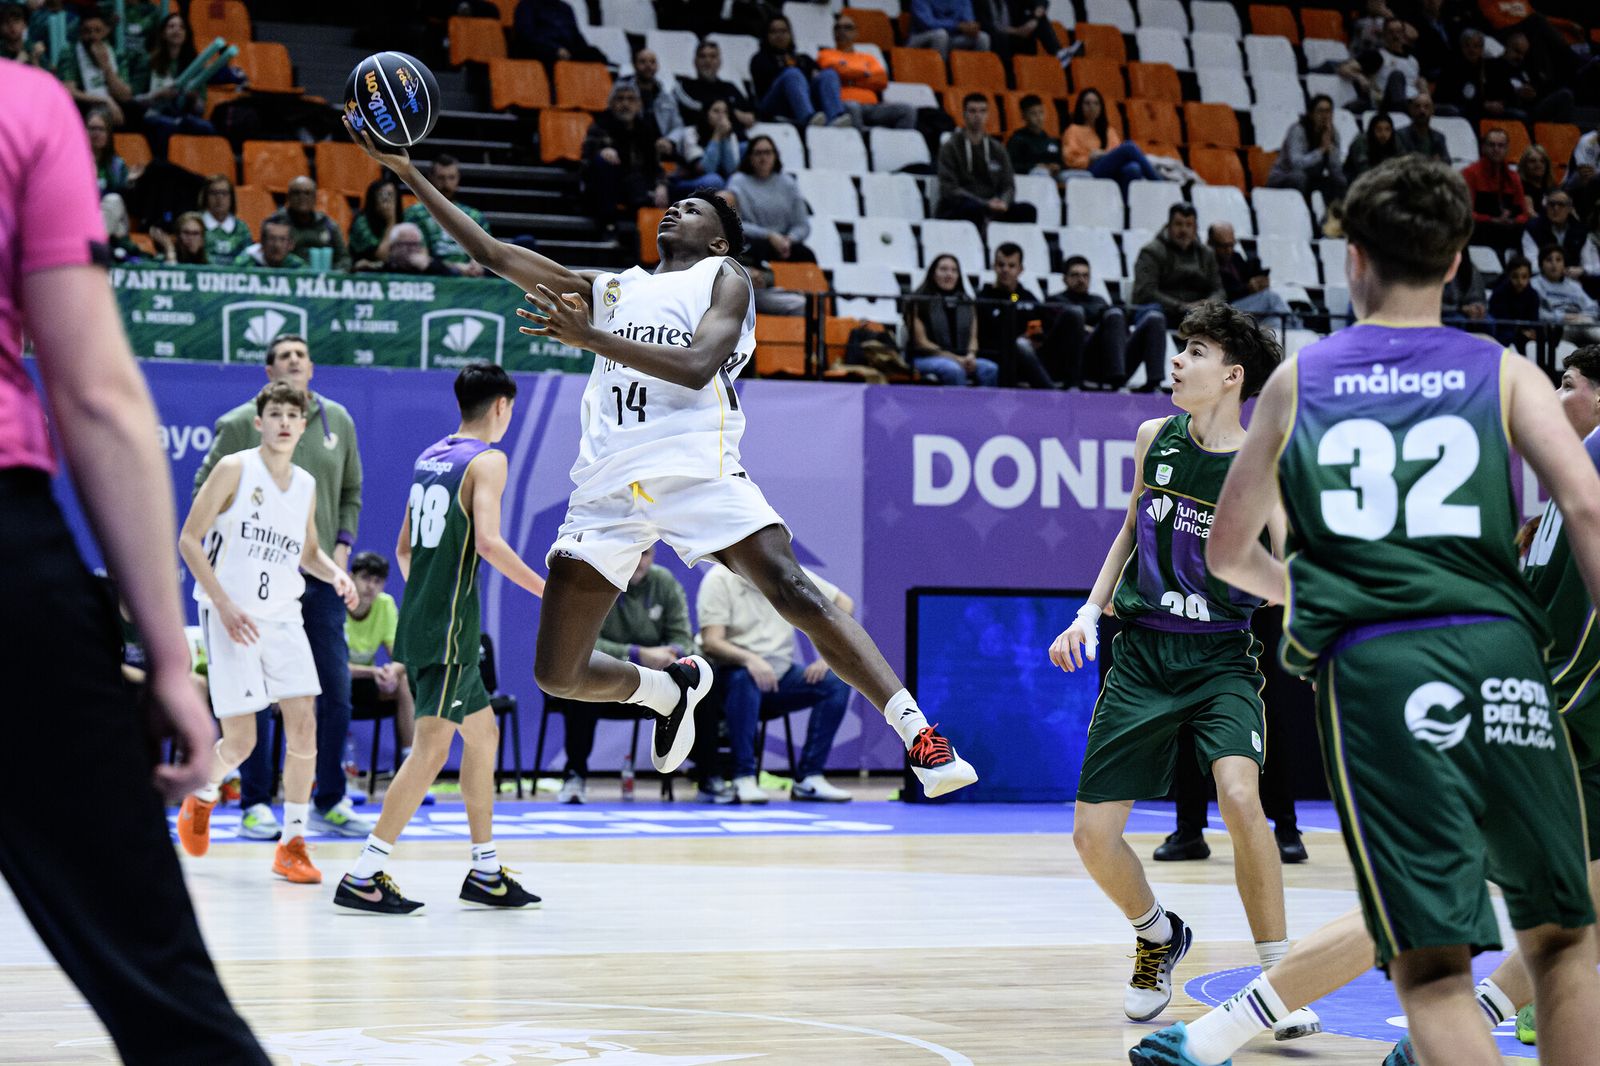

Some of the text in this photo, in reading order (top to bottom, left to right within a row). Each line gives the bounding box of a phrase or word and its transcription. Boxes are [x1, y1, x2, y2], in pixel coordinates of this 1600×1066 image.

[364, 70, 397, 135] Wilson
[197, 272, 291, 296] UNICAJA
[295, 272, 384, 301] MÁLAGA
[612, 381, 647, 425] 14
[1317, 414, 1482, 541] 32
[409, 483, 450, 549] 18
[258, 571, 270, 601] 8
[1483, 703, 1526, 725] DEL
[1484, 722, 1556, 751] MÁLAGA
